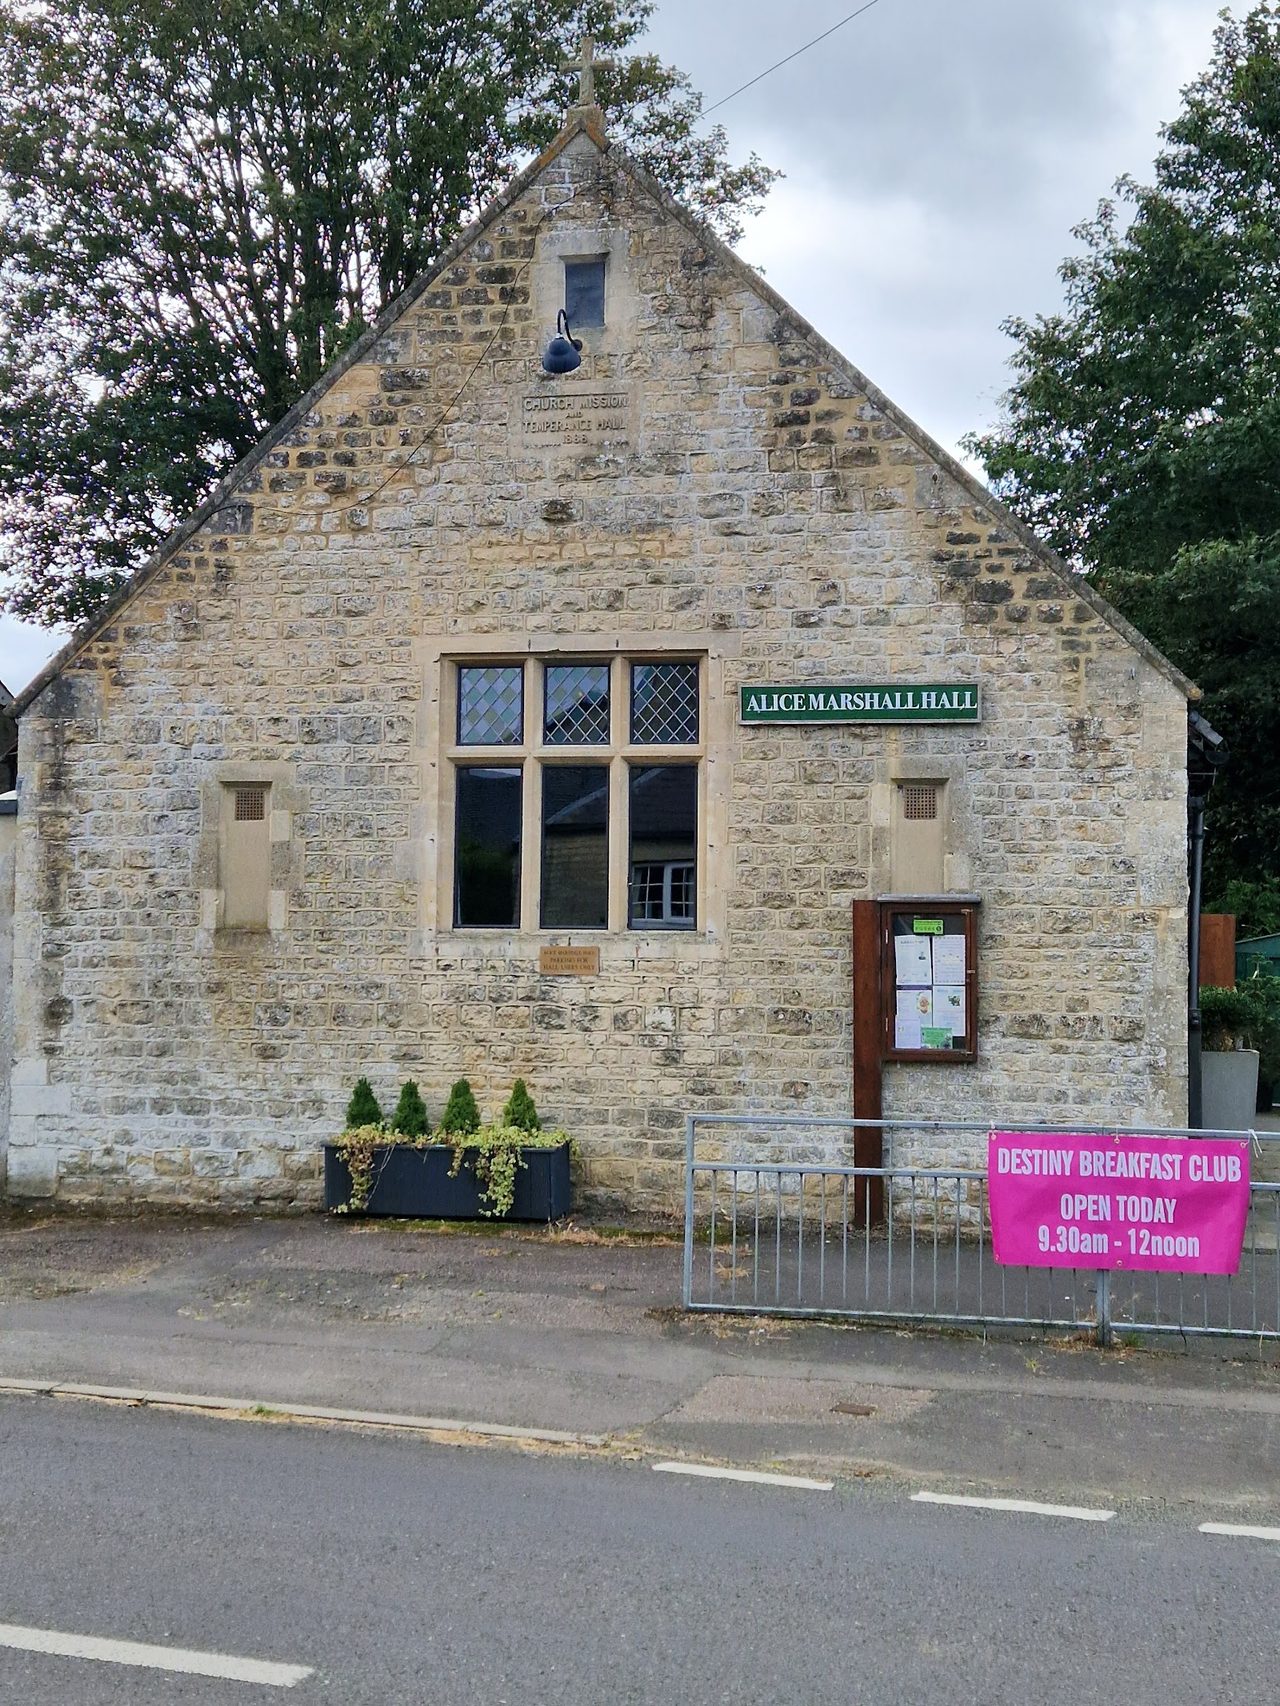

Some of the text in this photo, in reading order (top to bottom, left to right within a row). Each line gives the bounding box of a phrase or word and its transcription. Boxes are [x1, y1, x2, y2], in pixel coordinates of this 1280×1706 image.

[524, 396, 629, 411] CHURCH MISSION
[523, 418, 626, 433] TEMPERANCE HALL
[746, 691, 978, 711] ALICE MARSHALL HALL
[997, 1148, 1242, 1183] DESTINY BREAKFAST CLUB
[1060, 1194, 1177, 1224] OPEN TODAY
[1038, 1225, 1109, 1254] 9.30am
[1127, 1228, 1200, 1257] 12noon
